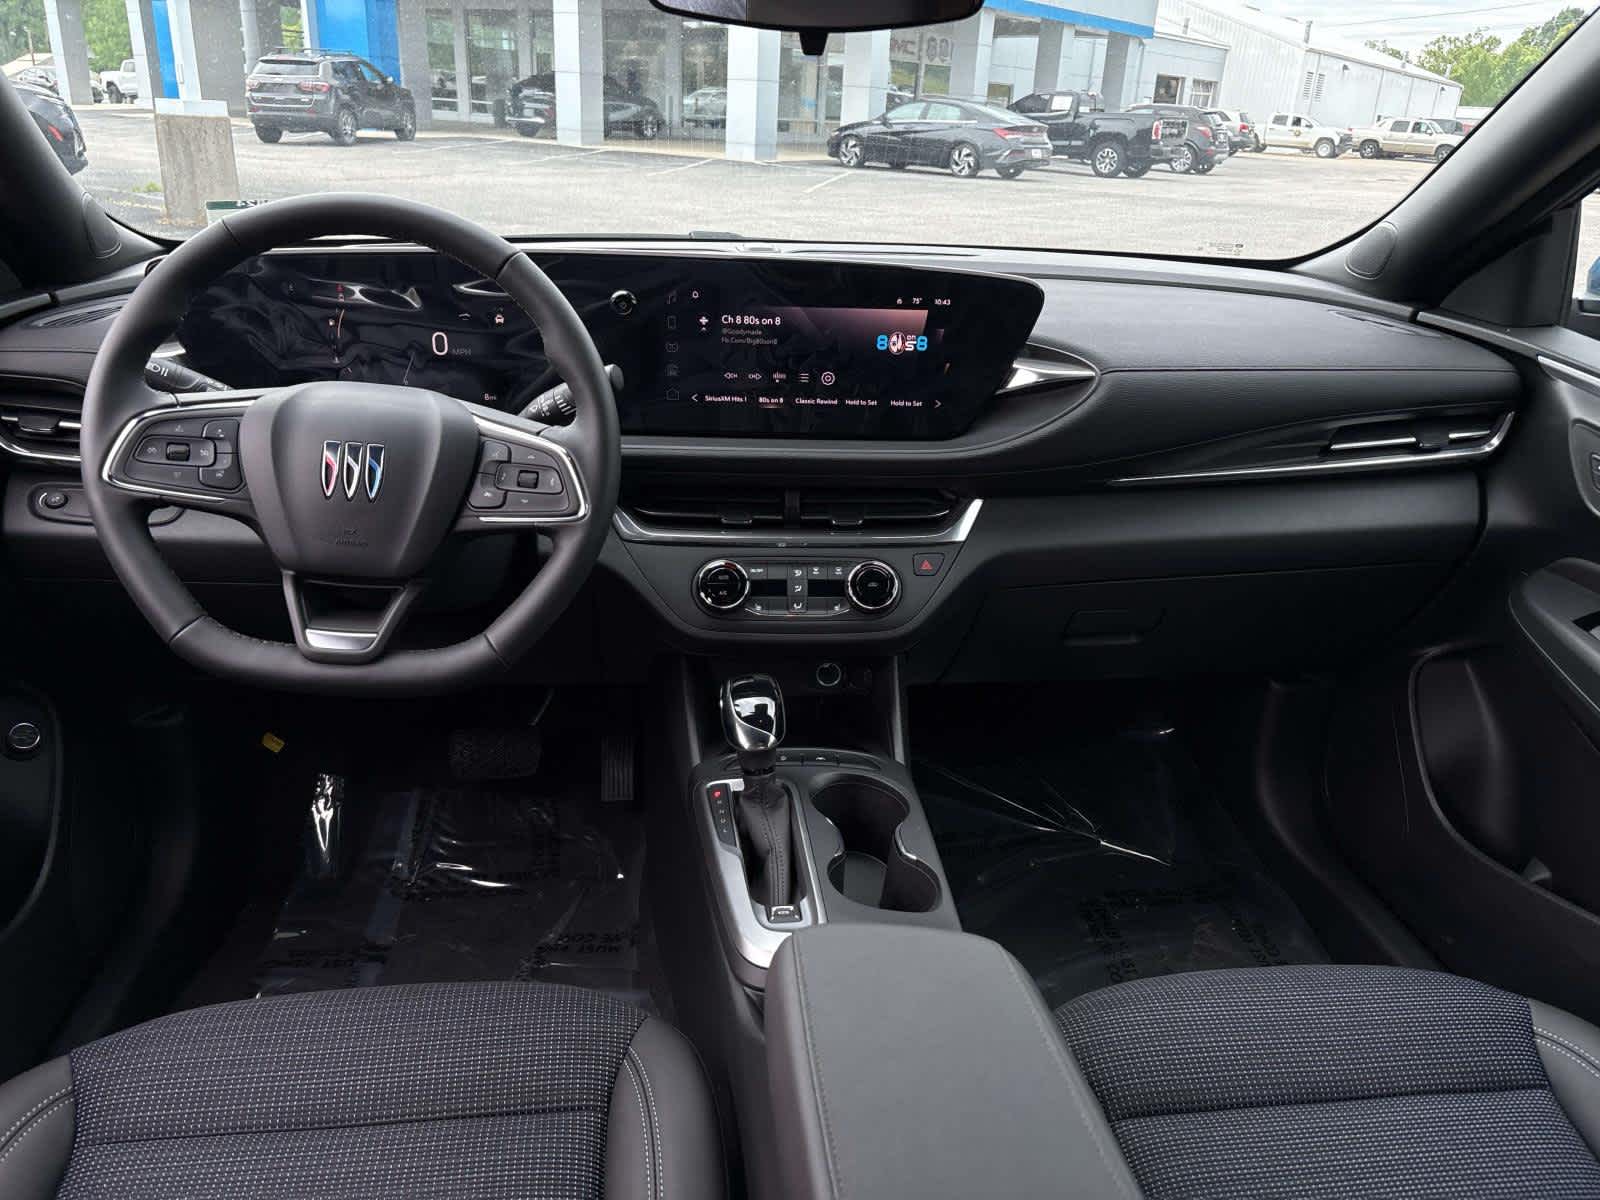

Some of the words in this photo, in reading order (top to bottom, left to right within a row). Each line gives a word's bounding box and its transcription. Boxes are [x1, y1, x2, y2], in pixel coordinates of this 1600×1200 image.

[721, 315, 734, 324] Ch
[735, 316, 742, 325] 8
[743, 316, 760, 325] 80s
[774, 317, 781, 326] 8
[431, 331, 448, 356] 0
